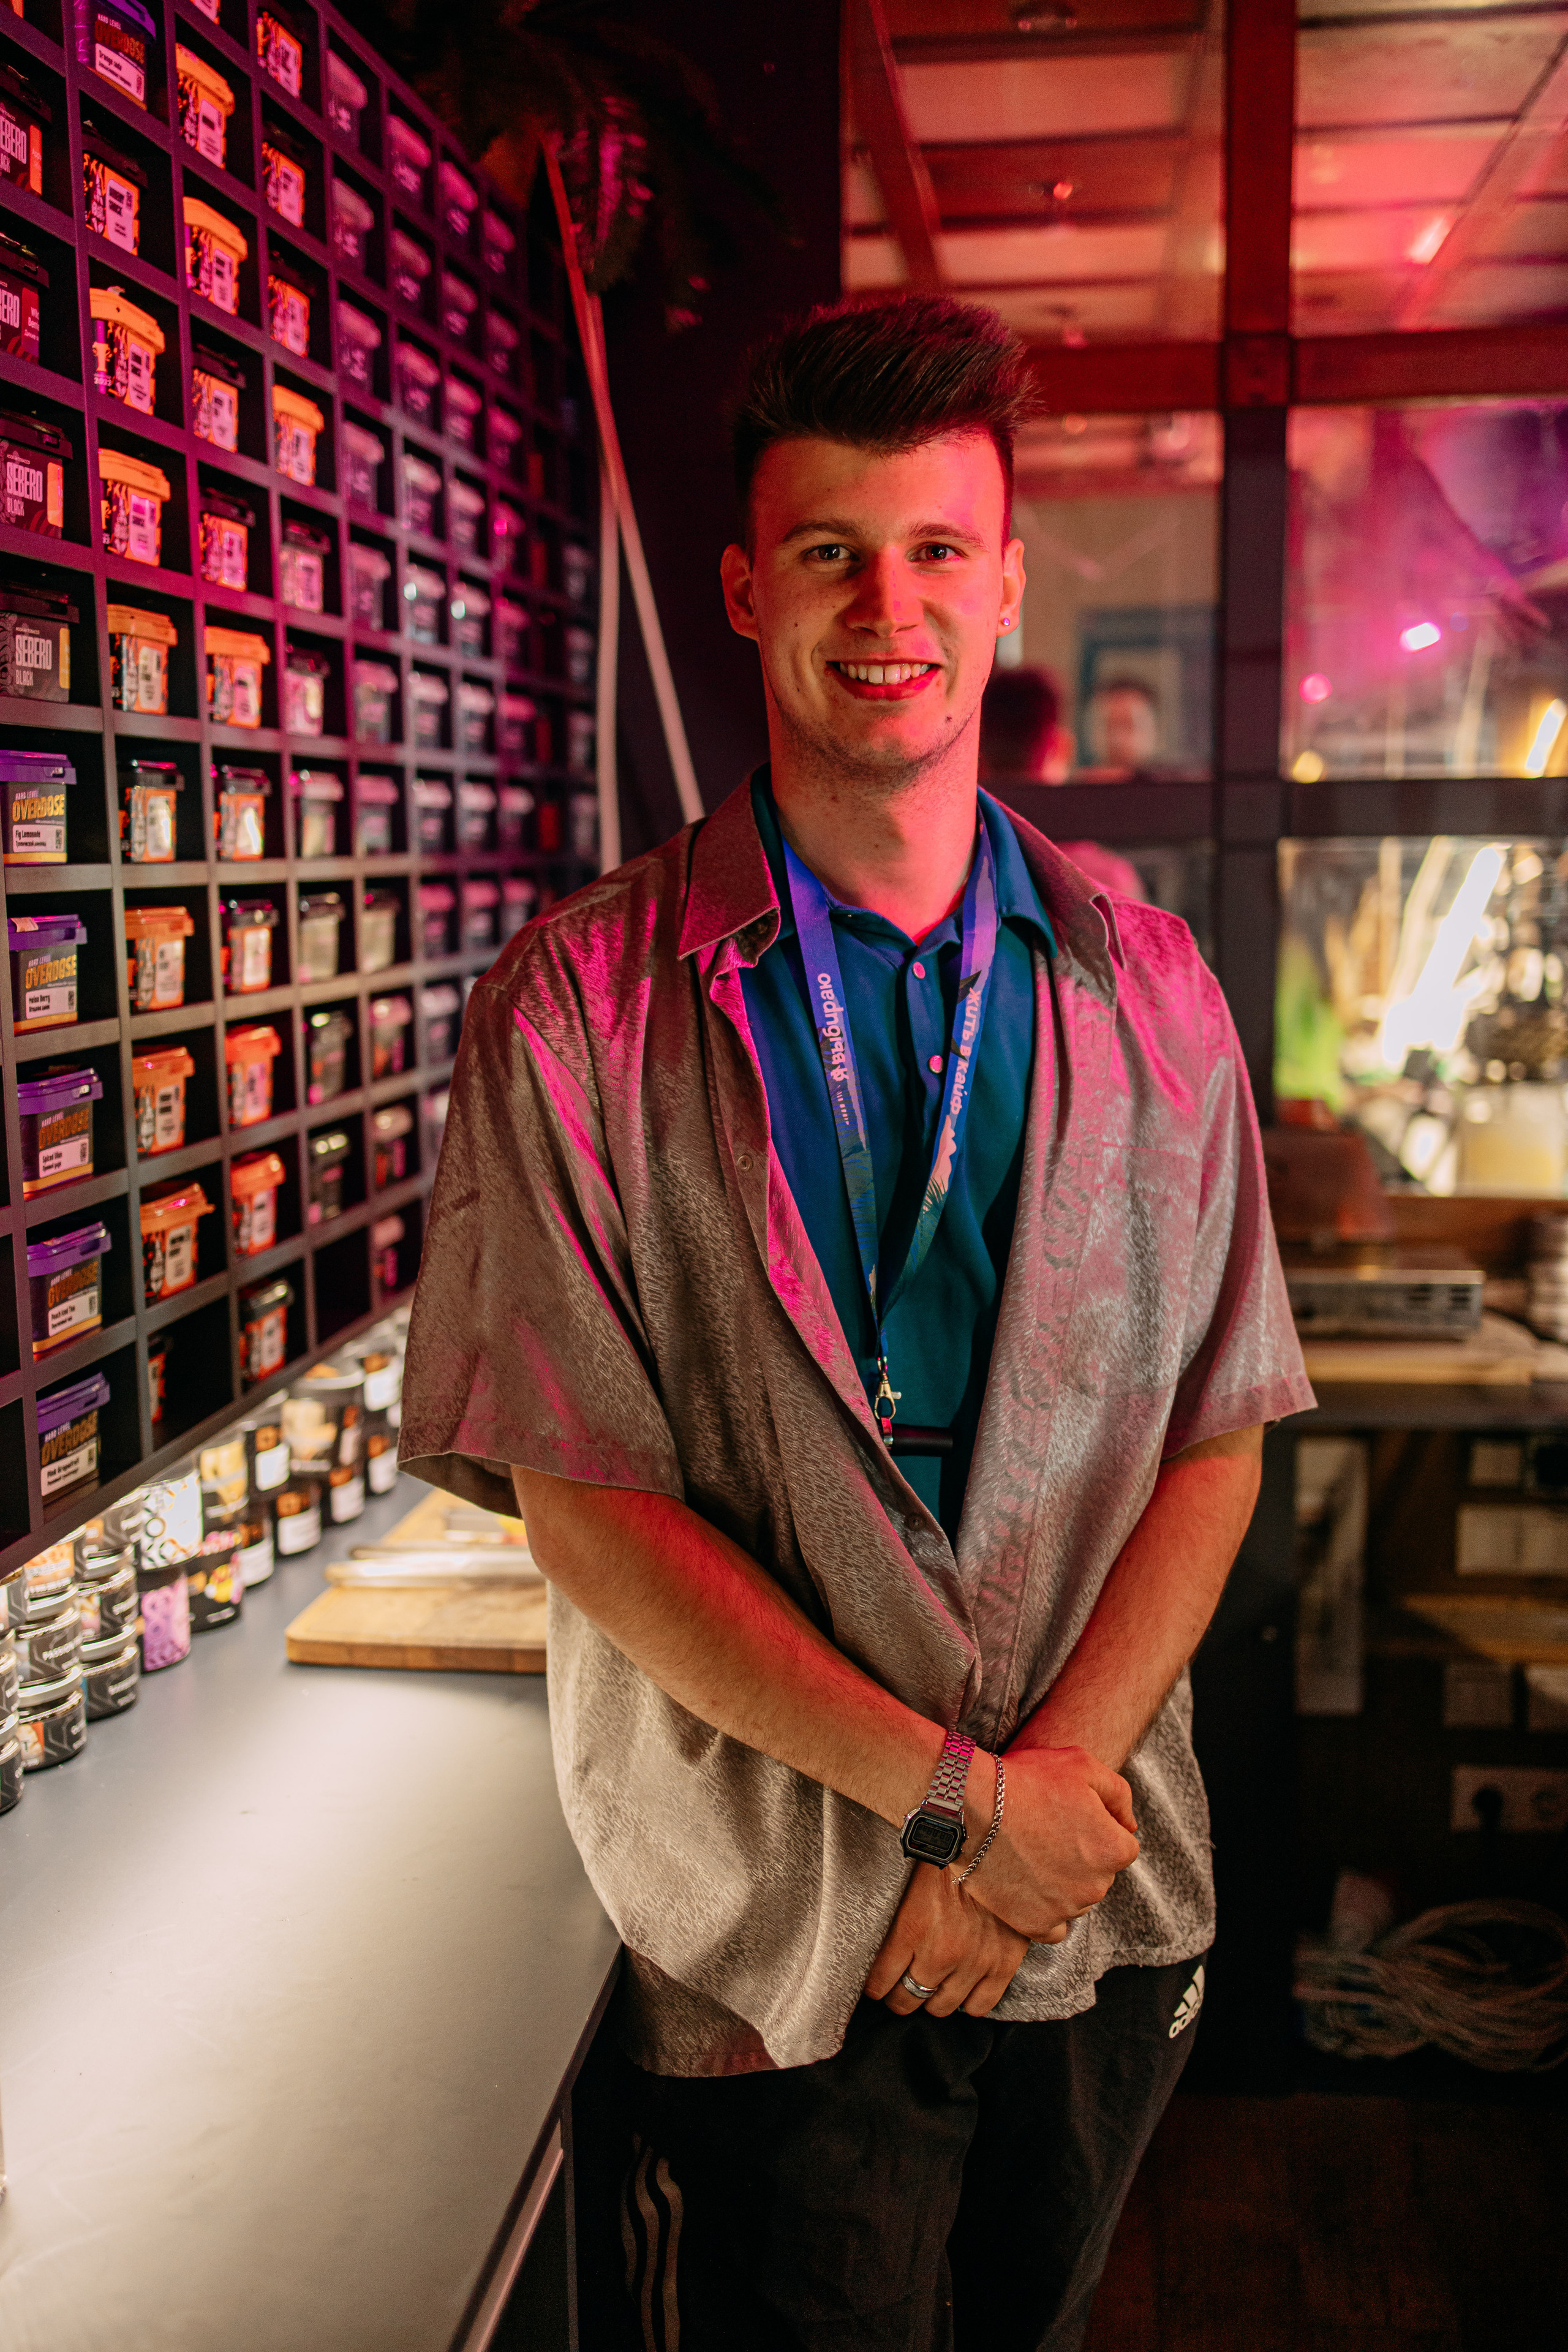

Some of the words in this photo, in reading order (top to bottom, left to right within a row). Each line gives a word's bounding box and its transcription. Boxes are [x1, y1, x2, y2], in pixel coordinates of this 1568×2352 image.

[6, 461, 43, 502] SEBERO
[7, 497, 24, 516] BLACK
[15, 634, 53, 671] SEBERO
[16, 669, 34, 686] BLACK
[12, 794, 65, 822] OVERDOSE
[25, 954, 77, 989] OVERDOSE
[817, 973, 846, 1065] выбираю
[960, 1045, 972, 1056] в
[829, 1065, 849, 1082] Я
[949, 1058, 968, 1116] кайф
[39, 1109, 89, 1149] OVERDOSE
[48, 1261, 98, 1308] OVERDOSE
[42, 1410, 98, 1466] OVERDOSE
